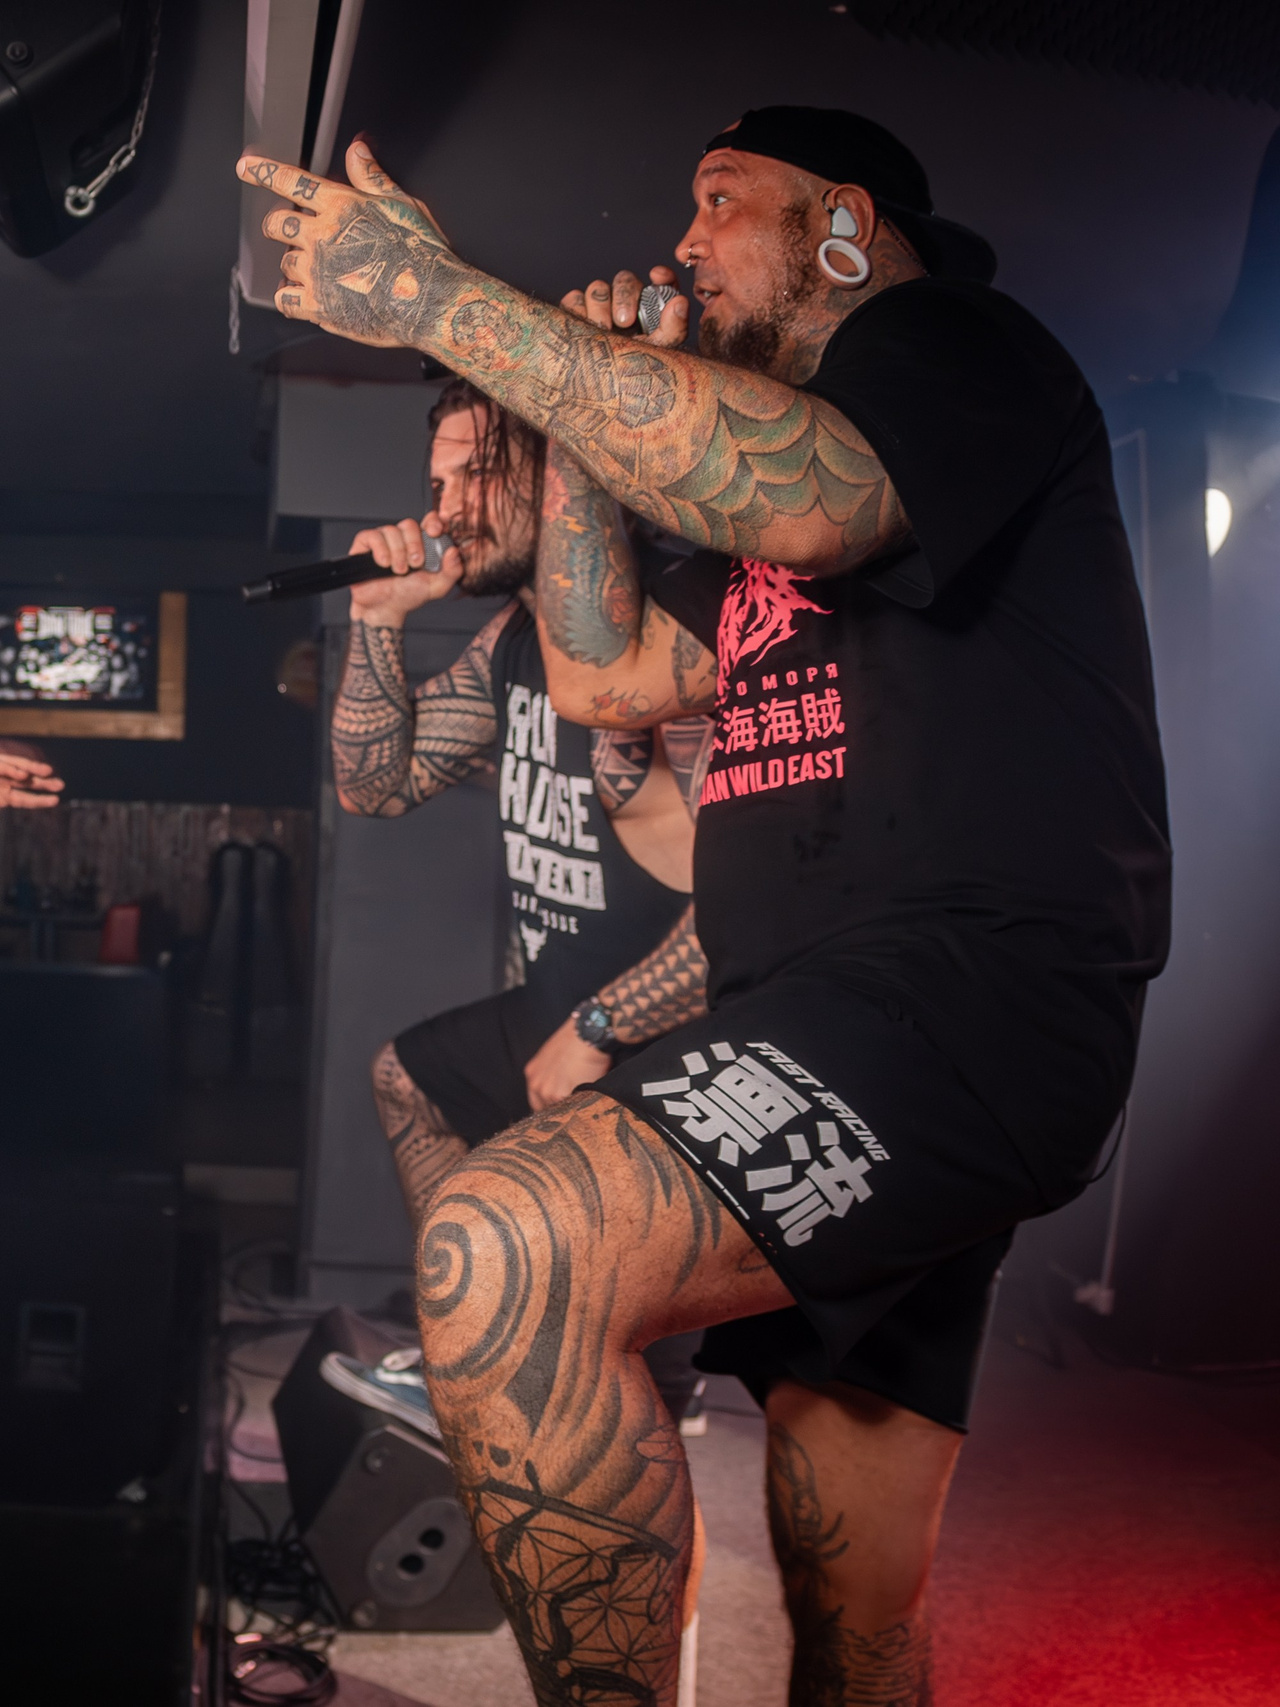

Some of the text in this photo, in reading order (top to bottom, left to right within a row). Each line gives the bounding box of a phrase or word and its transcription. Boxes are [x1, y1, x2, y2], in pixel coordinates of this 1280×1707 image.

[761, 663, 839, 691] МОРЯ
[710, 687, 846, 759] 海海賊
[728, 757, 785, 798] WILD
[786, 746, 847, 786] EAST
[746, 1041, 892, 1162] FAST RACING
[641, 1041, 874, 1248] 漂流
